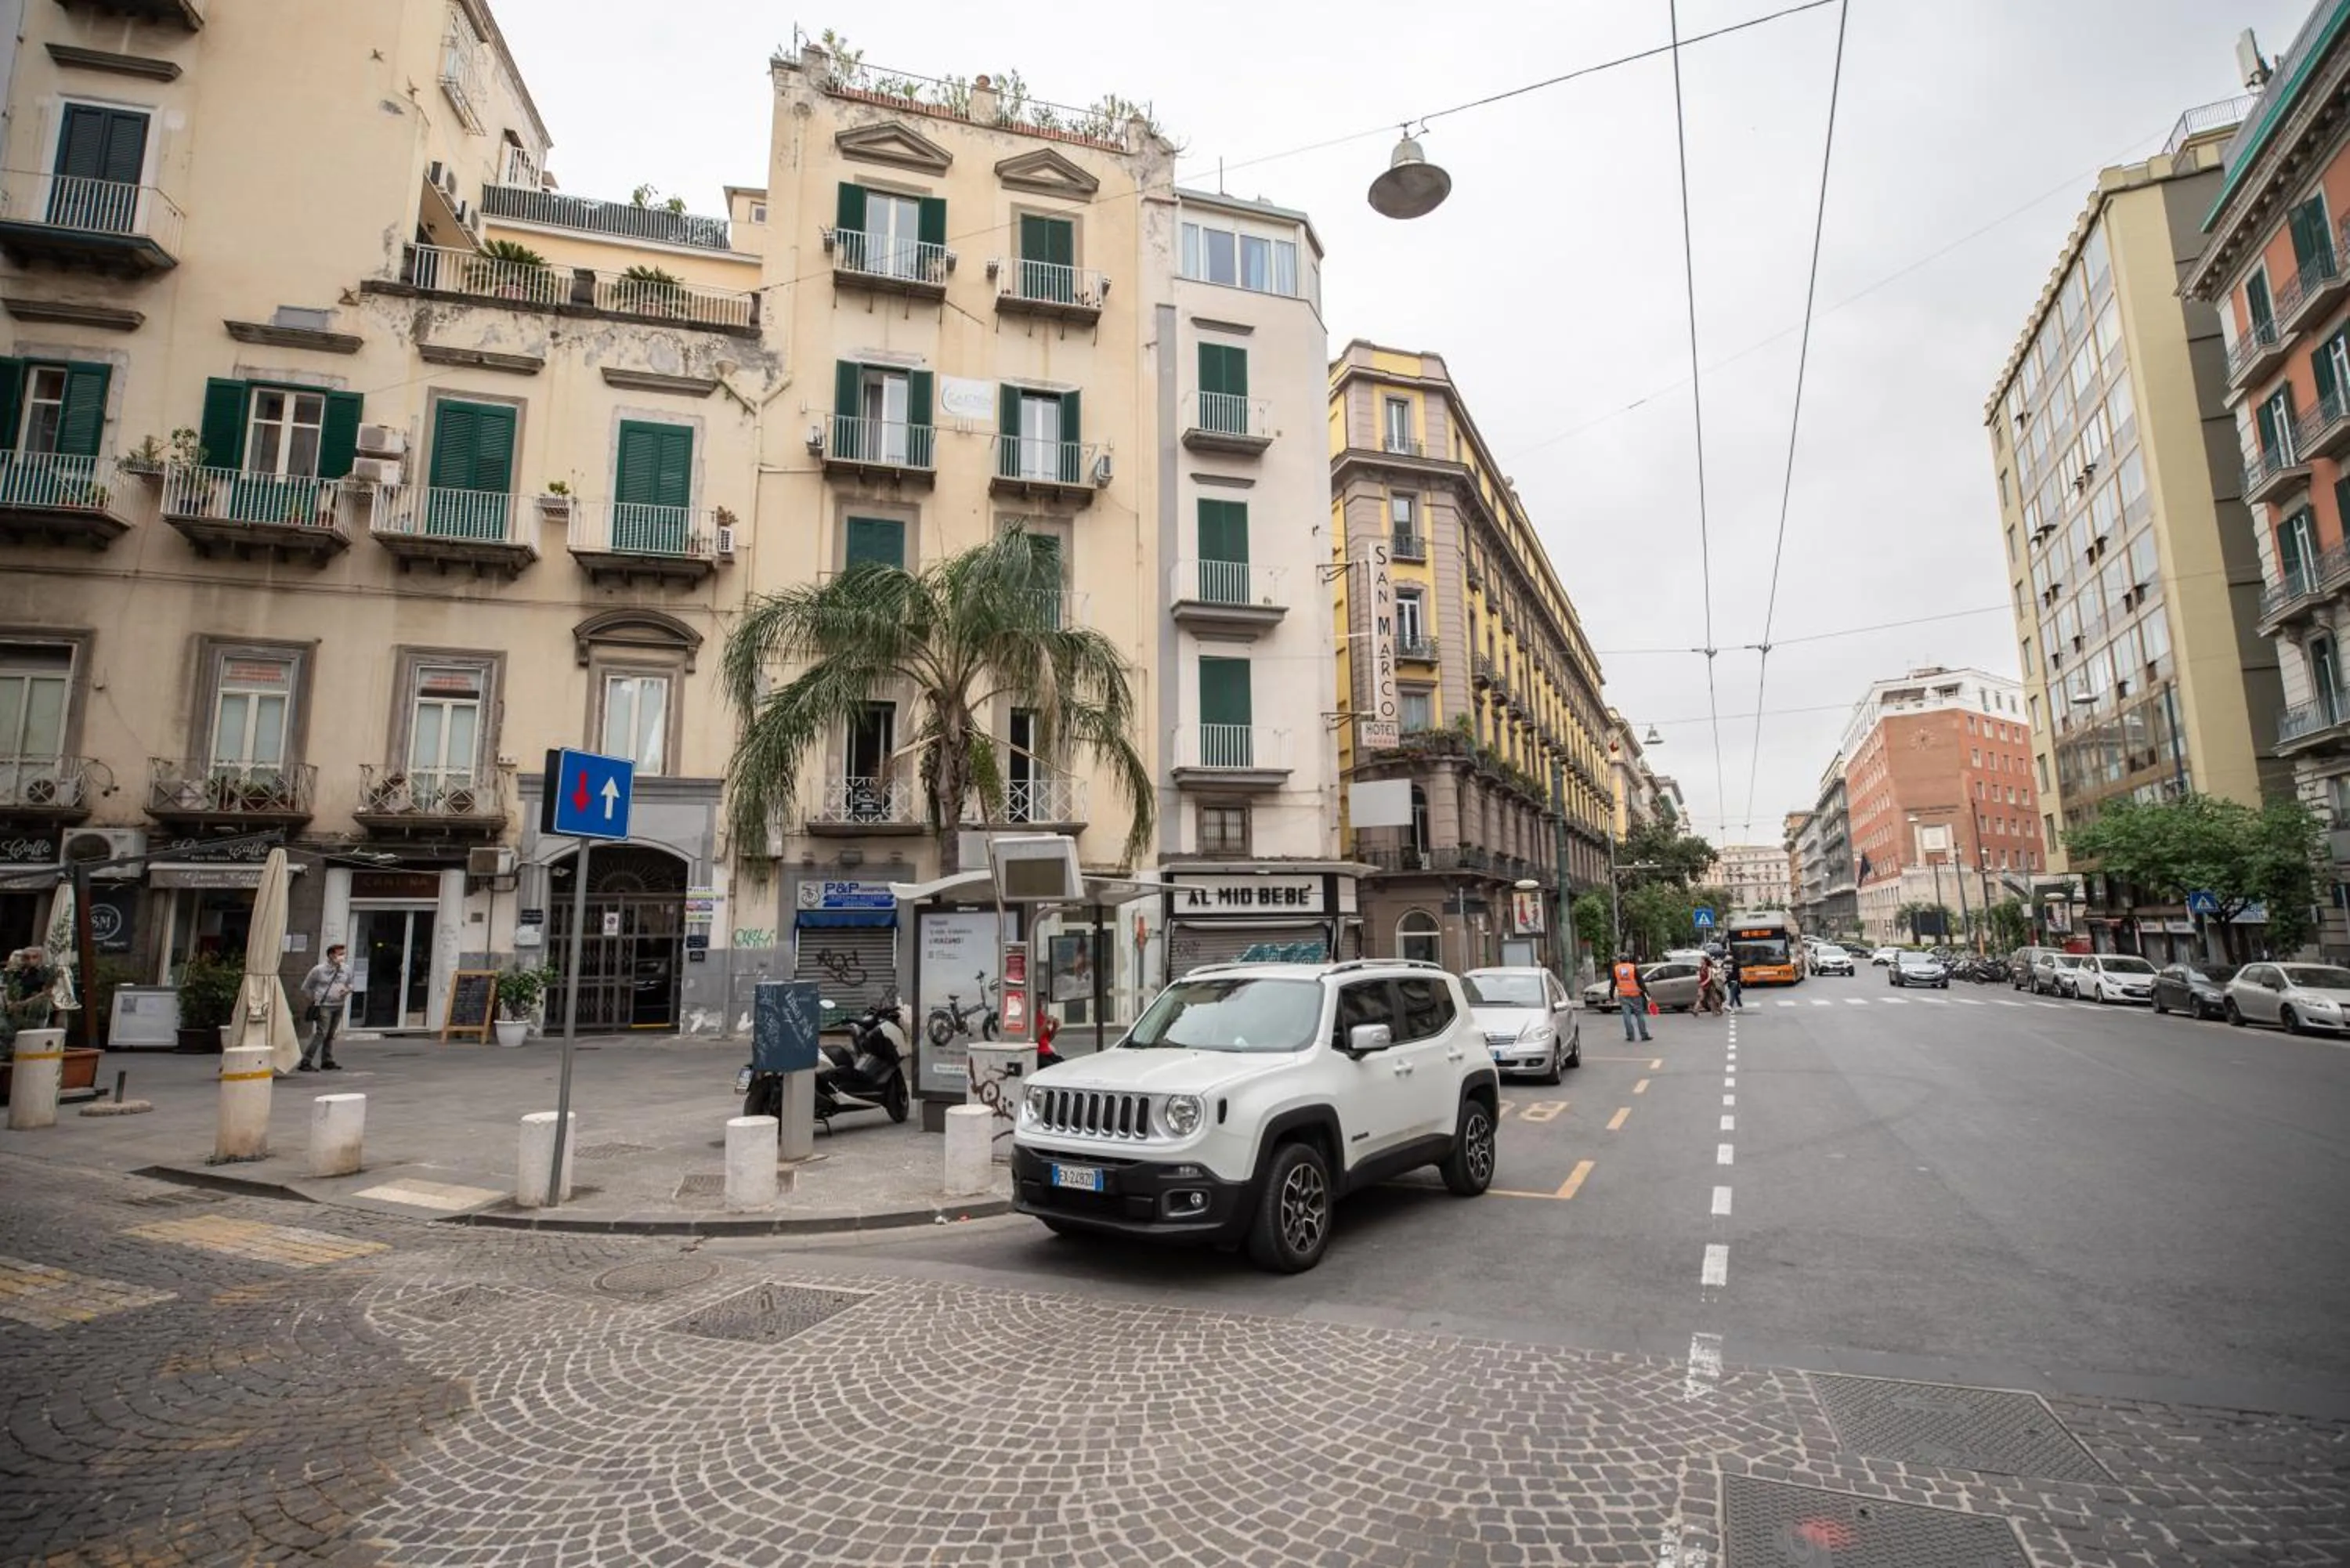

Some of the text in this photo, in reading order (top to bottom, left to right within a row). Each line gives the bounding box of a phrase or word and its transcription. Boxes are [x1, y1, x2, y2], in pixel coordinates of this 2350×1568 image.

[1375, 545, 1395, 717] SAN MARCO
[1365, 723, 1396, 737] HOTEL
[824, 883, 859, 894] P&P
[1188, 888, 1211, 906] AL
[1218, 887, 1253, 905] MIO
